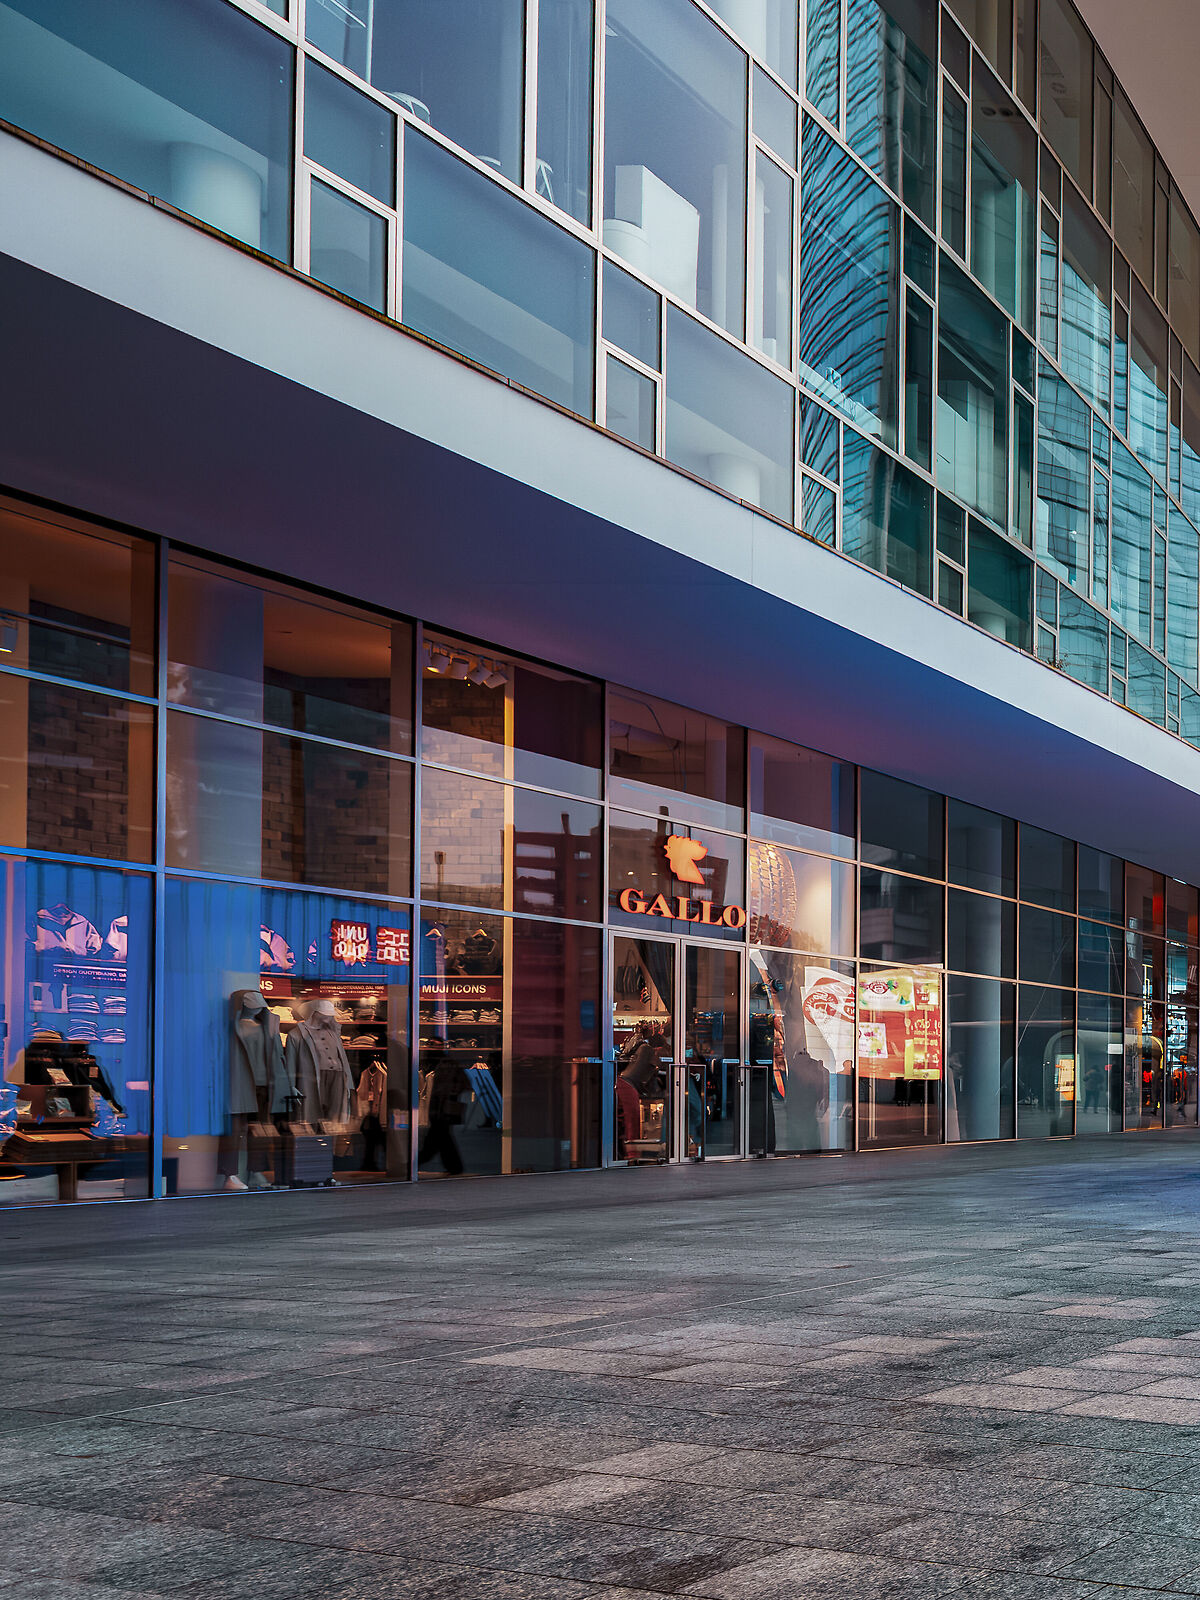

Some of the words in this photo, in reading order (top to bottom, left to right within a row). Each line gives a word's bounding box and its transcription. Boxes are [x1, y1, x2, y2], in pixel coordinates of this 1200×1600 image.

[619, 887, 747, 929] GALLO
[422, 984, 449, 994] MUJI
[451, 984, 487, 994] ICONS
